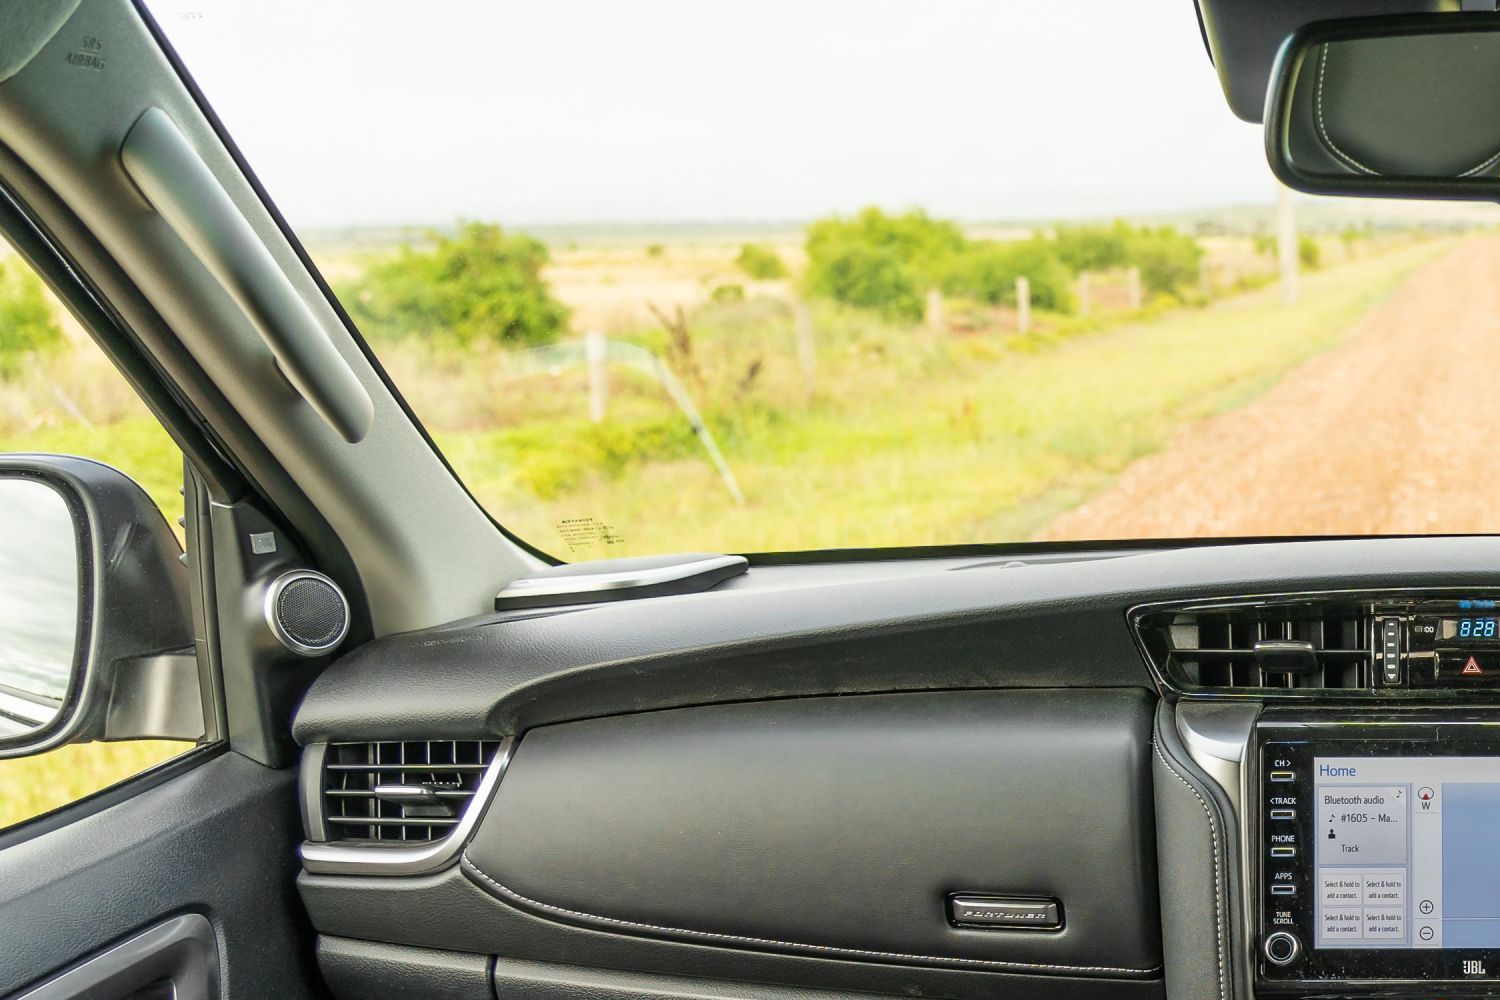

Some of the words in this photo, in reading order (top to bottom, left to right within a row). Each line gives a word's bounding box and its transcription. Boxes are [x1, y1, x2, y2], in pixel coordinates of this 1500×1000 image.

[81, 36, 102, 49] SRS
[64, 52, 105, 70] AIRBAG
[1319, 764, 1357, 777] Home
[1324, 795, 1362, 805] Bluetooth
[1363, 795, 1385, 805] audio
[1421, 801, 1431, 810] W
[1341, 813, 1368, 823] #1605
[1271, 834, 1295, 842] PHONE
[1341, 844, 1360, 853] Track
[1274, 872, 1293, 880] APPS
[1324, 880, 1338, 888] Select
[1344, 880, 1354, 888] hold
[1366, 880, 1380, 888] Select
[1386, 880, 1396, 888] hold
[1463, 960, 1486, 974] JBL
